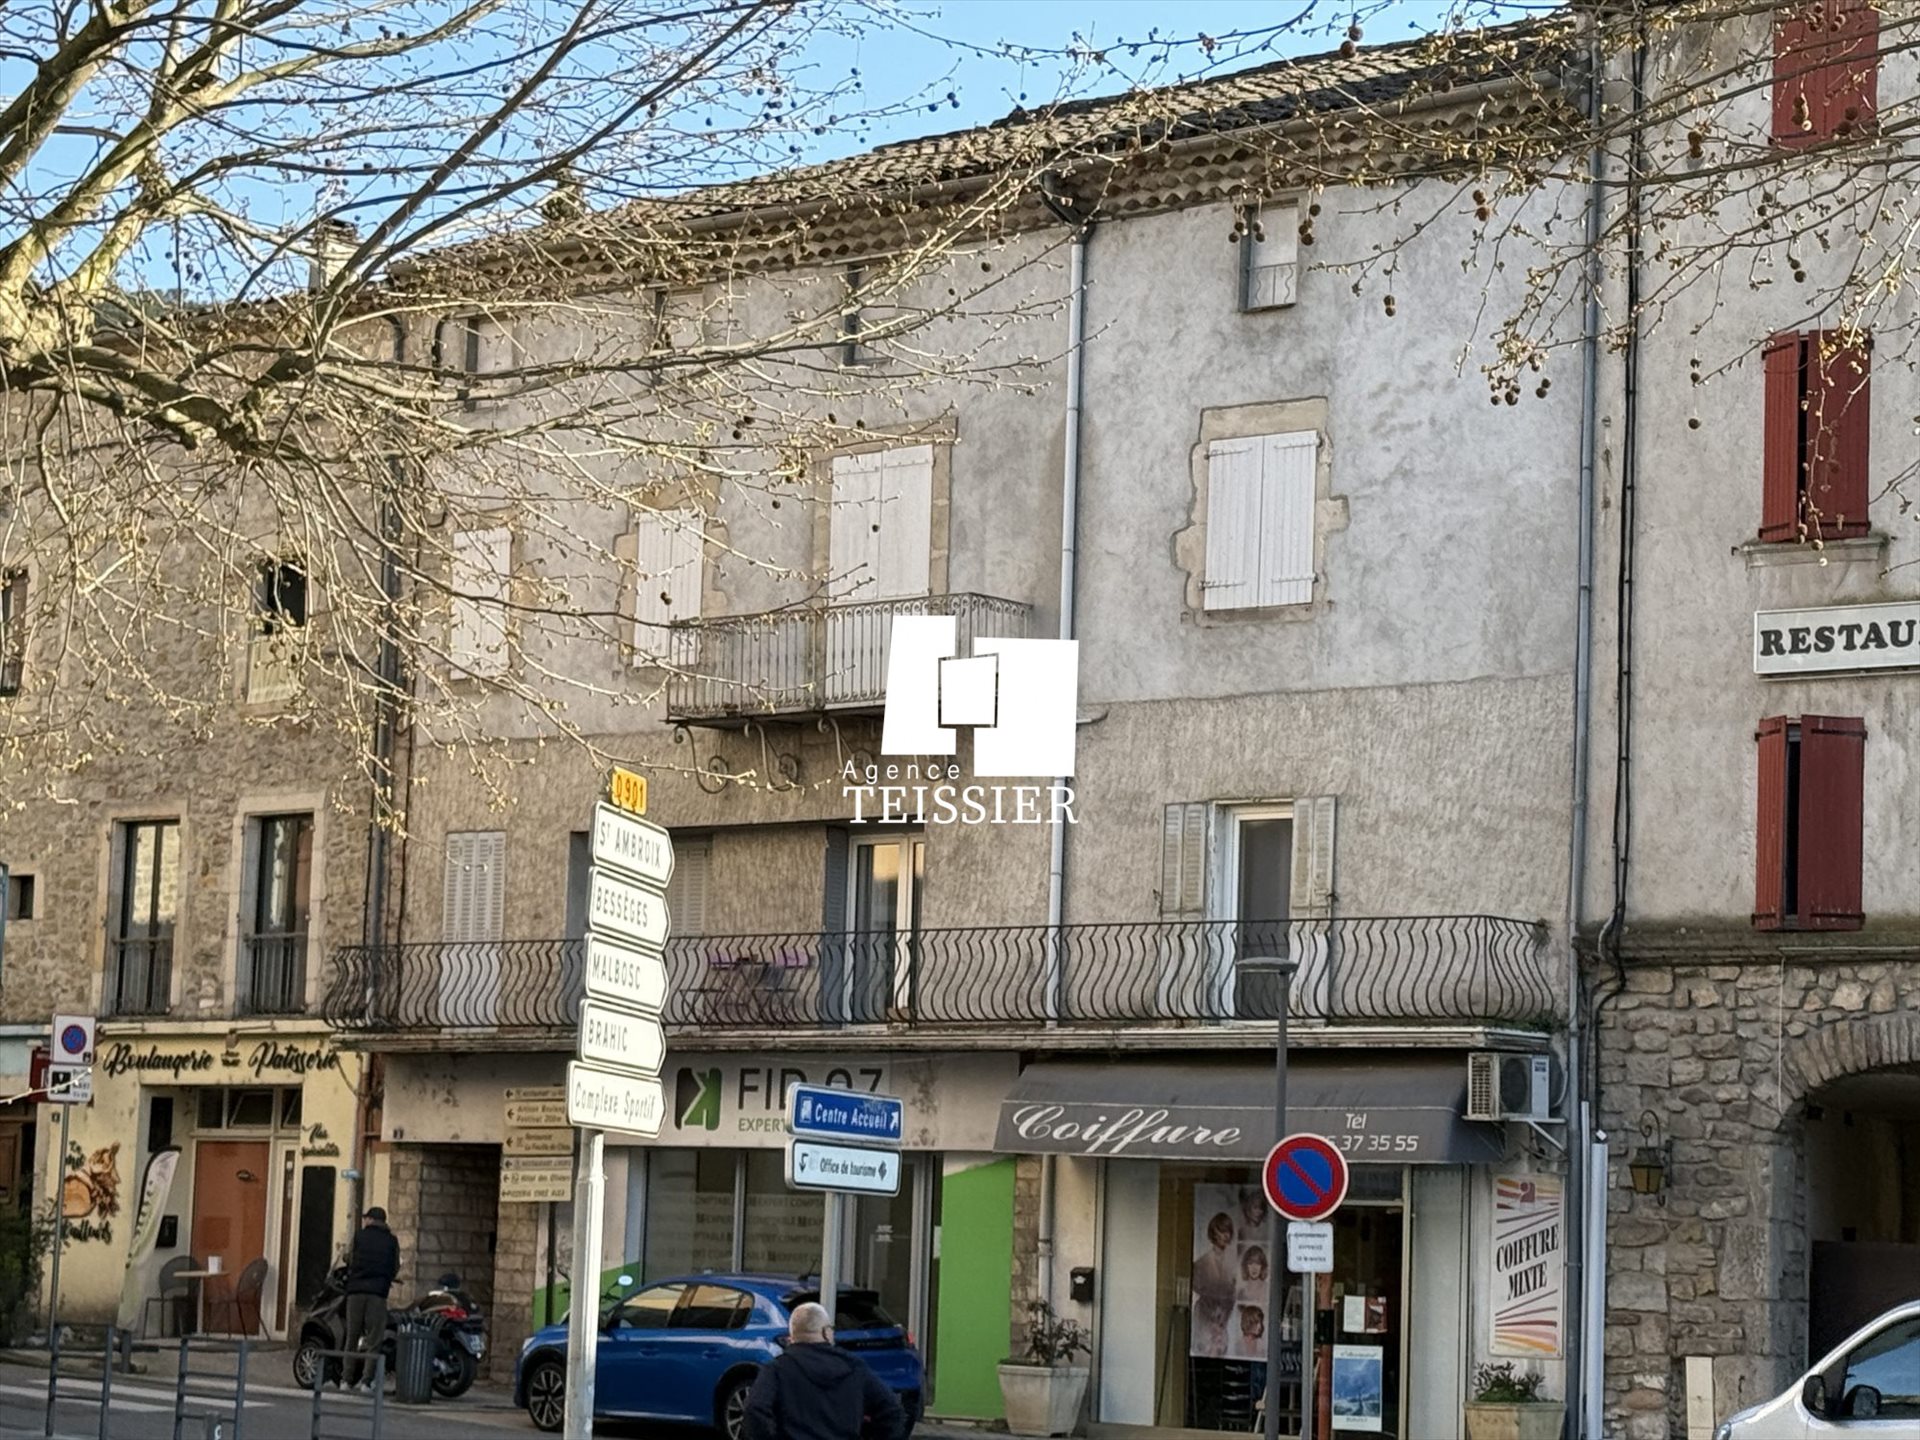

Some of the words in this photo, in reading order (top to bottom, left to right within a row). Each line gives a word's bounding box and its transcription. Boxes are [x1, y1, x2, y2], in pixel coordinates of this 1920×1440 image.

[615, 825, 661, 869] AMBROIX
[596, 885, 649, 929] BESSÈGES
[592, 957, 641, 991] MALBOSC
[588, 1018, 629, 1053] BRAHIC
[103, 1042, 215, 1079] Boulangerie
[574, 1082, 619, 1118] Complexe
[624, 1090, 656, 1123] Sportif
[738, 1068, 808, 1110] FID
[738, 1117, 786, 1132] EXPERT
[815, 1102, 848, 1125] Centre
[851, 1107, 887, 1130] Accueil
[1012, 1105, 1240, 1154] Coiffure
[1340, 1135, 1364, 1152] 37
[1368, 1135, 1391, 1151] 35
[1395, 1135, 1419, 1151] 55
[820, 1157, 840, 1173] Office
[841, 1159, 849, 1175] de
[850, 1161, 877, 1177] tourisme
[1496, 1222, 1559, 1272] COIFFURE
[1508, 1261, 1548, 1301] MIXTE
